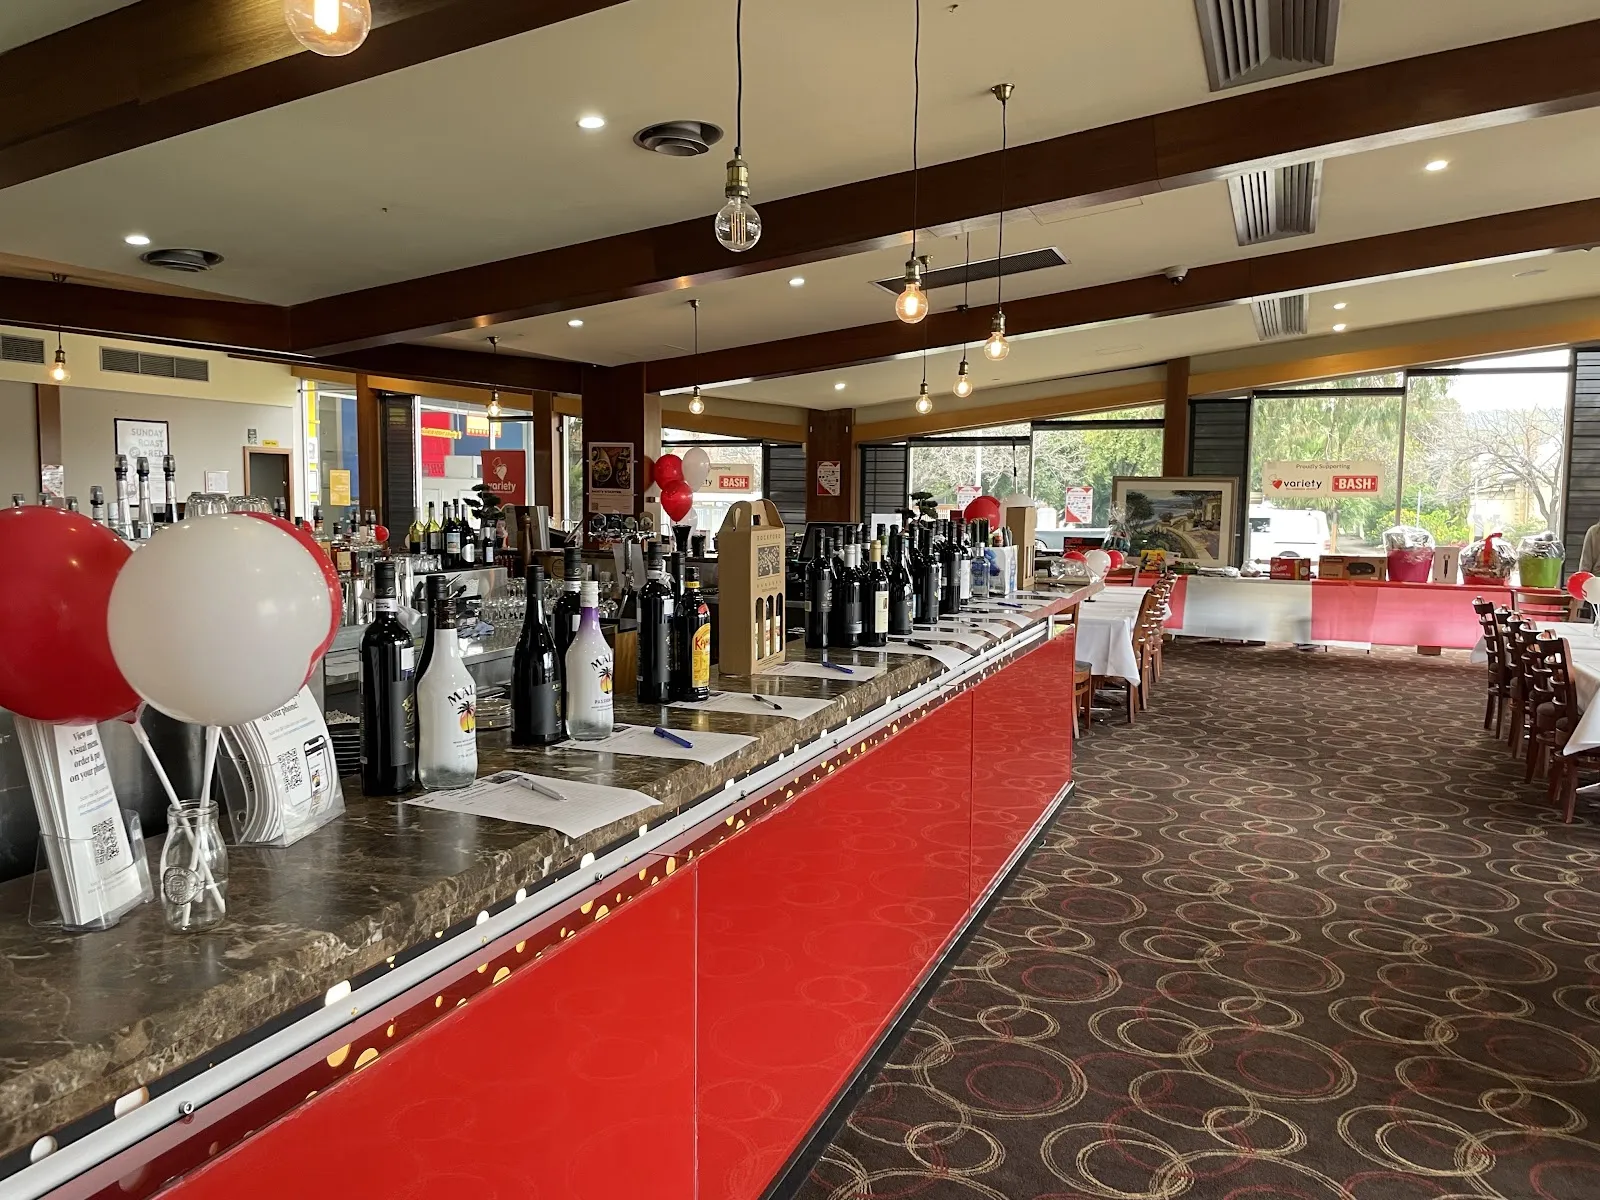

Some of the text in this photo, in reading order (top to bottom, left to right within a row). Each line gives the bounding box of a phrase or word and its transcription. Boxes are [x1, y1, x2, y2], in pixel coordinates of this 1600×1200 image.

[131, 428, 164, 437] SUNDAY
[138, 438, 164, 448] ROAST
[487, 481, 517, 493] variety
[723, 477, 746, 488] BASH
[1283, 479, 1322, 489] variety
[1338, 478, 1372, 490] BASH
[72, 731, 86, 741] View
[69, 742, 87, 756] visual
[74, 755, 90, 768] order
[69, 774, 80, 783] on
[80, 768, 93, 781] your
